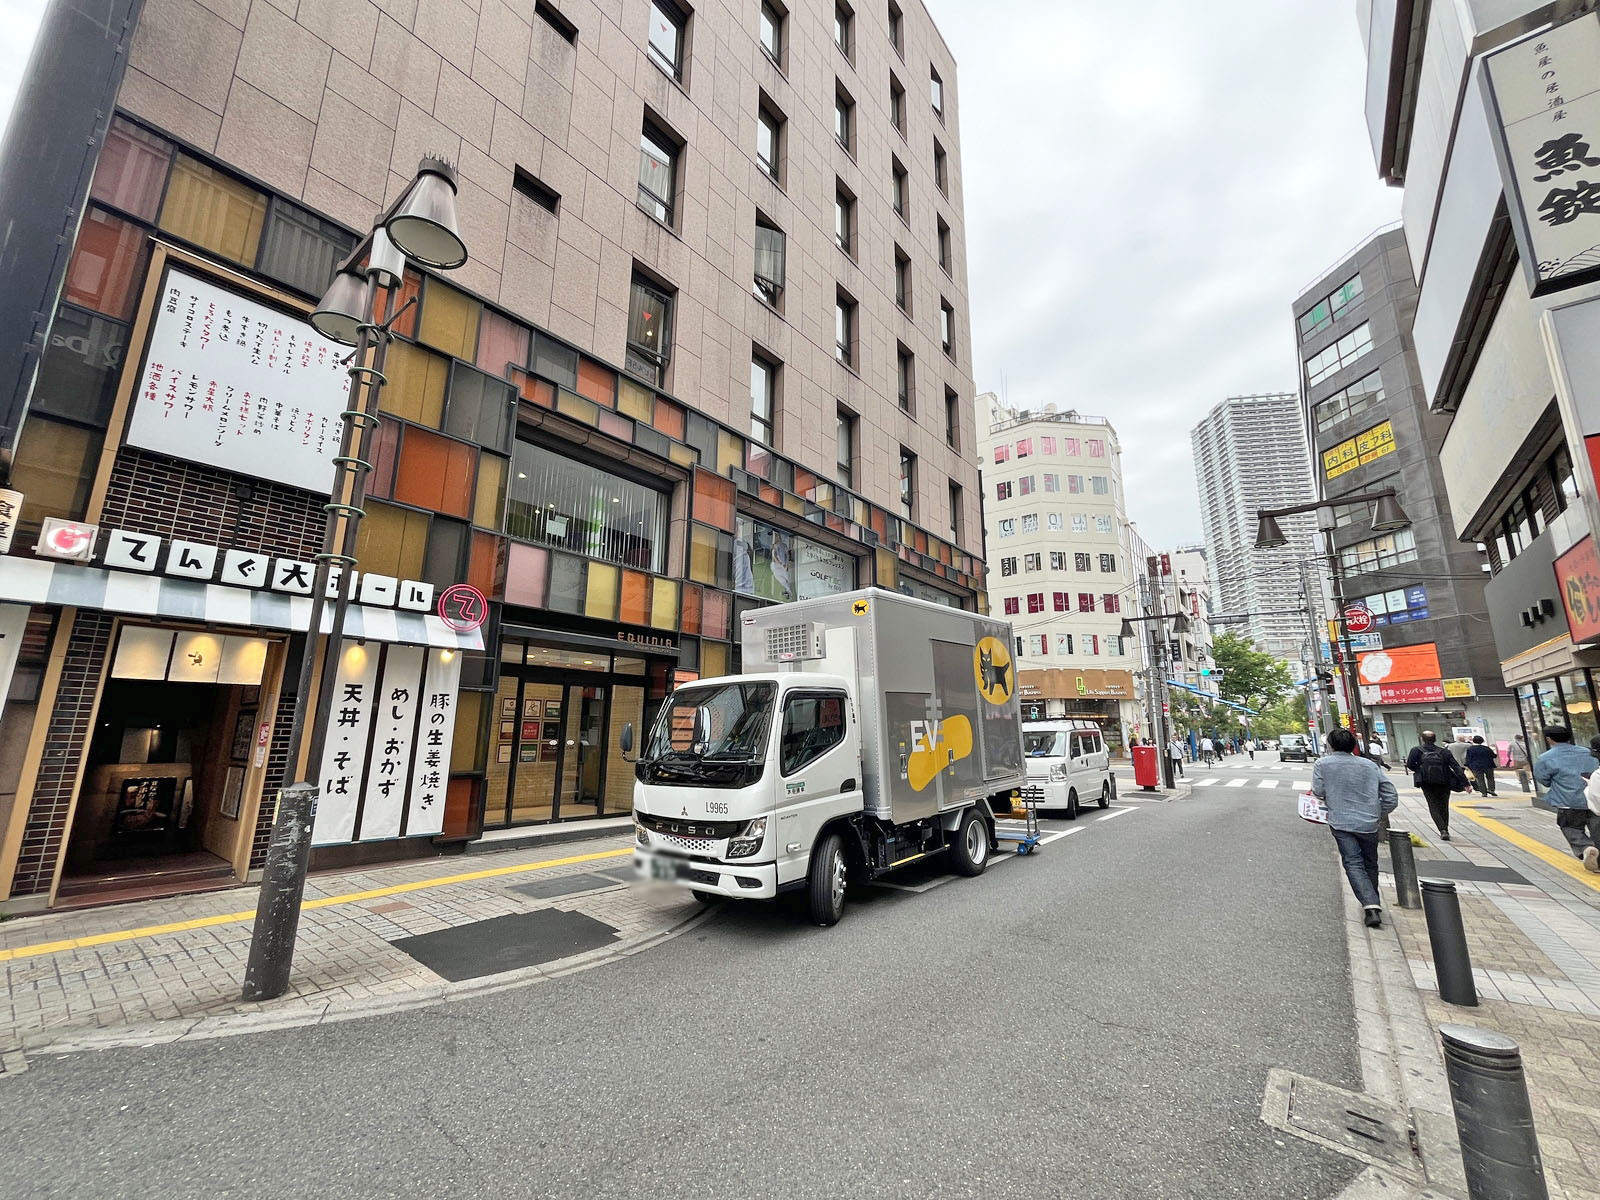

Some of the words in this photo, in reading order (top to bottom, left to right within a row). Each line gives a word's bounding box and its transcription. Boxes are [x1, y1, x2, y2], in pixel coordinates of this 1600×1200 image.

[1534, 42, 1568, 122] 魚屋の居酒屋
[282, 335, 296, 374] もやしナムル
[144, 362, 164, 401] 地酒各種
[184, 374, 200, 418] レモンサワー
[214, 385, 234, 447] クリームメロンソーダ
[302, 412, 314, 445] ナポリタン
[316, 416, 328, 454] カレーライス
[1327, 447, 1354, 467] 内科
[1360, 428, 1392, 452] 皮フ科
[617, 631, 672, 648] EQUINIA
[326, 683, 364, 795] 天丼・そば
[377, 688, 409, 799] めし・おかず
[420, 693, 450, 810] 豚の生姜焼き
[910, 720, 939, 753] EV
[705, 801, 729, 815] L9965
[655, 822, 715, 836] FUSO
